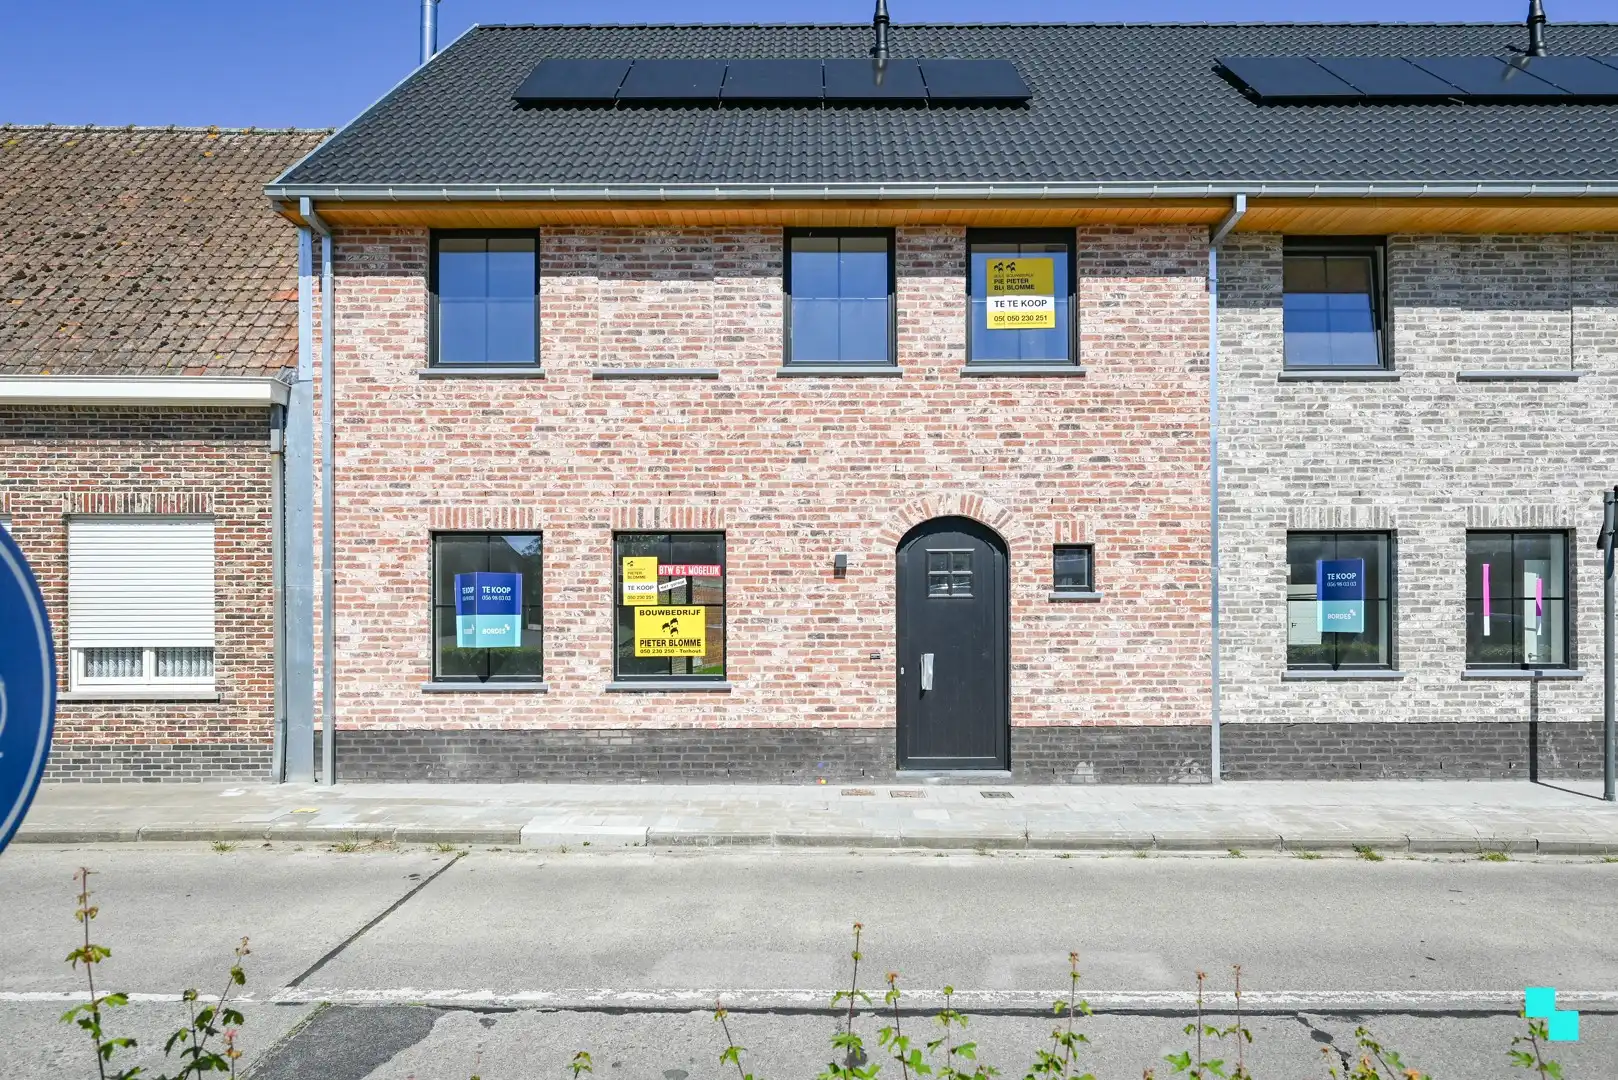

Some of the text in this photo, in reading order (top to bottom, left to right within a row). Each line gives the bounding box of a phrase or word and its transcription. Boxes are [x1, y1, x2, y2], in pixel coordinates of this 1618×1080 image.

[1007, 299, 1047, 308] TE KOOP
[659, 565, 673, 575] BTW
[687, 565, 719, 575] MOGELIJK
[1336, 572, 1356, 580] KOOP
[482, 586, 511, 594] TE KOOP
[640, 639, 702, 647] PIETER BLOMME
